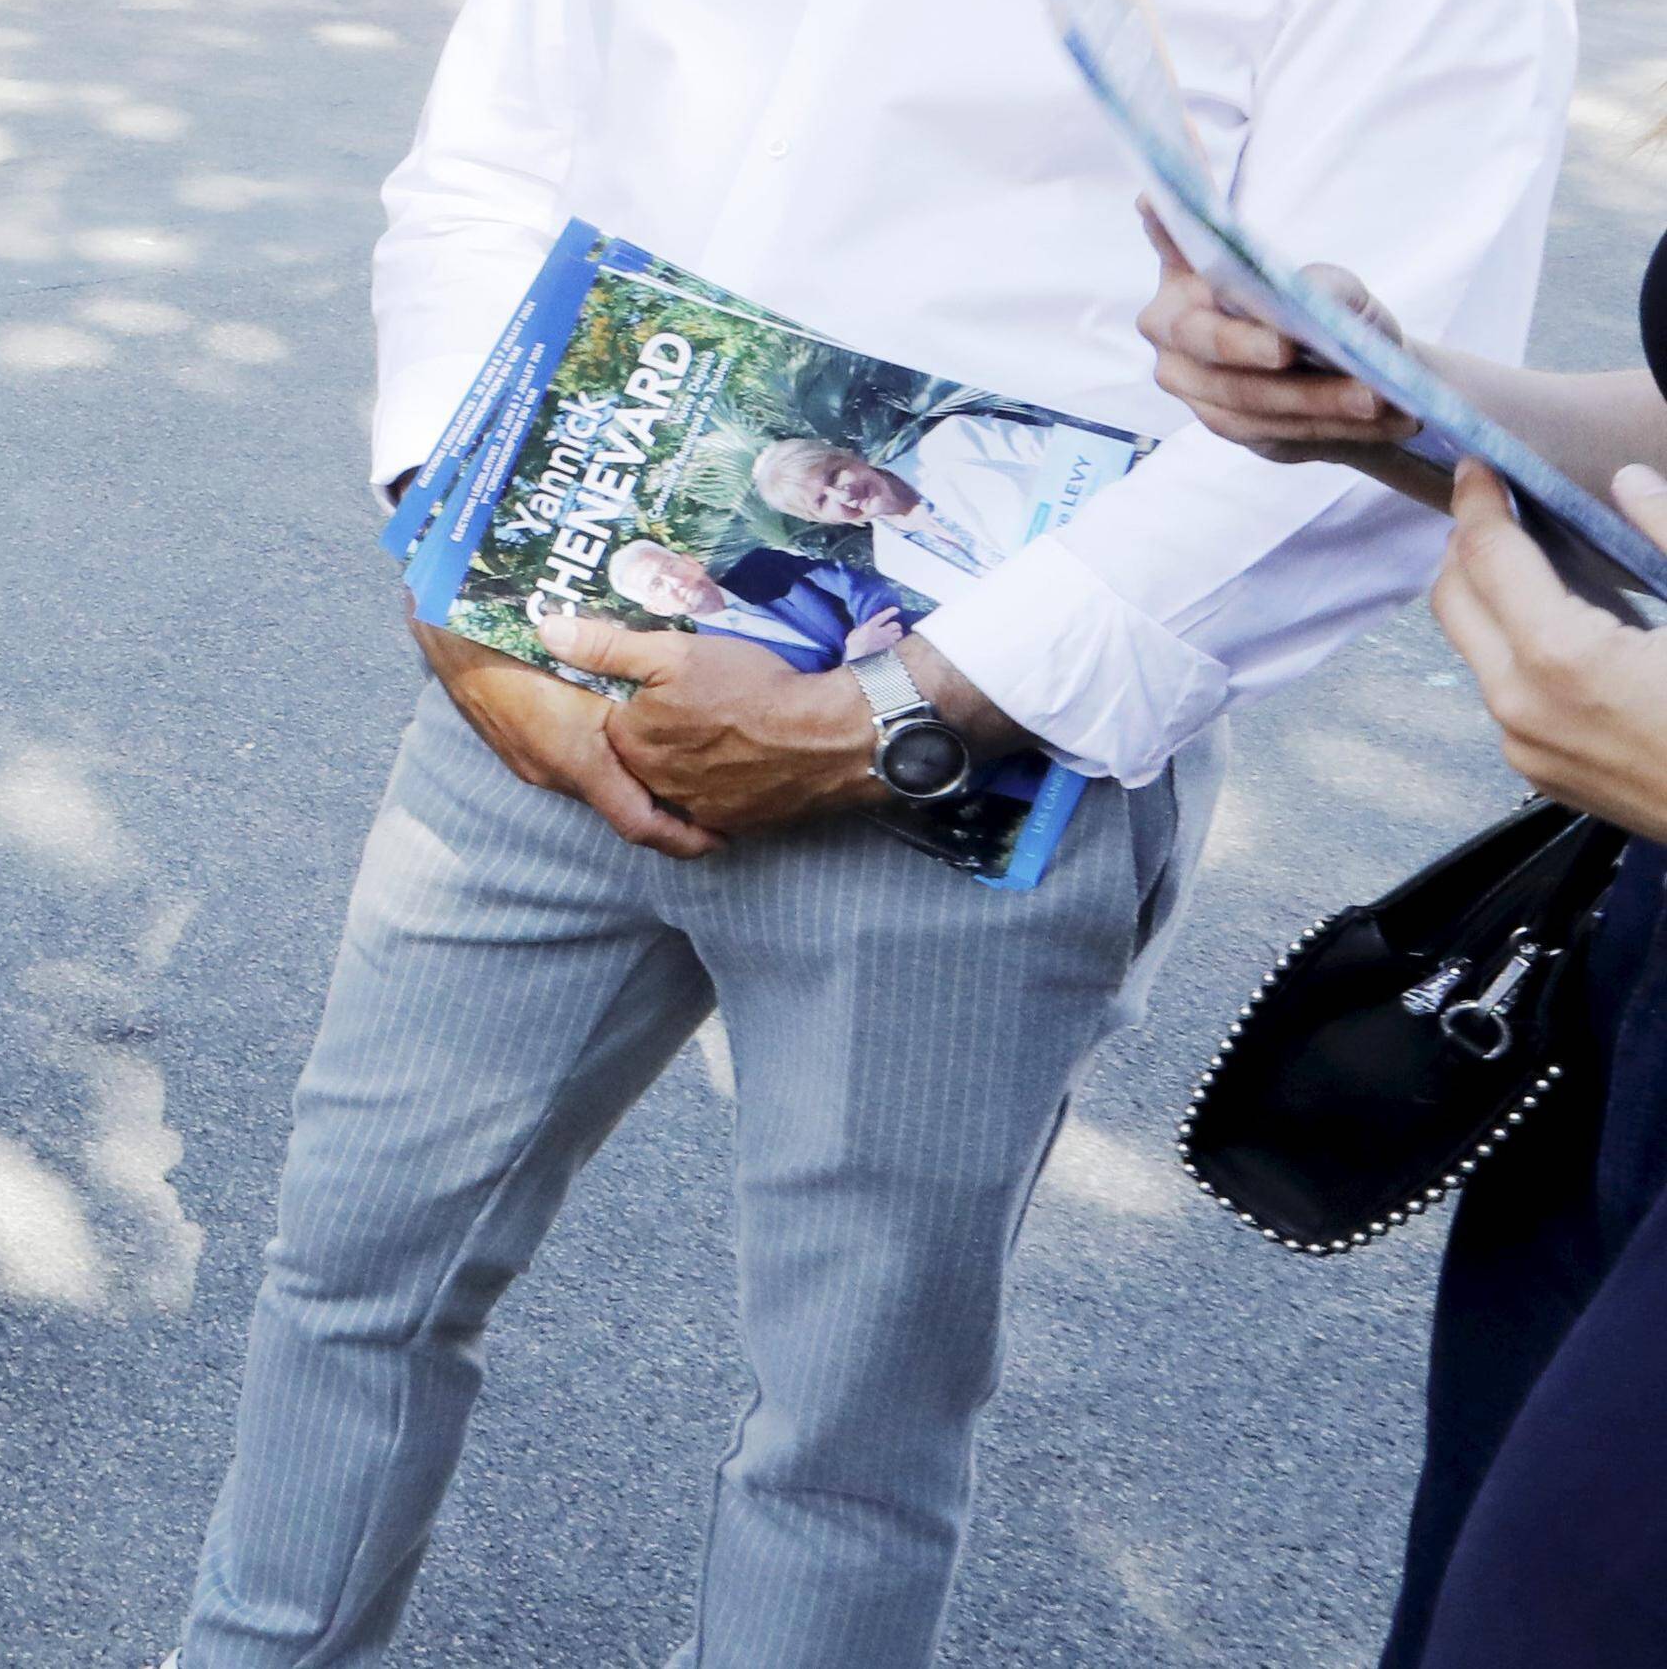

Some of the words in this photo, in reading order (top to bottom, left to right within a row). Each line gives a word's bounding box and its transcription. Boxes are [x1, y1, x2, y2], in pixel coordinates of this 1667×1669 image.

[671, 394, 696, 425] Votre
[686, 350, 715, 393] Député
[698, 395, 714, 412] de
[704, 356, 732, 394] Toulon
[505, 390, 608, 532] Yannick
[526, 332, 692, 625] CHENEVARD
[1060, 455, 1091, 507] LEVY
